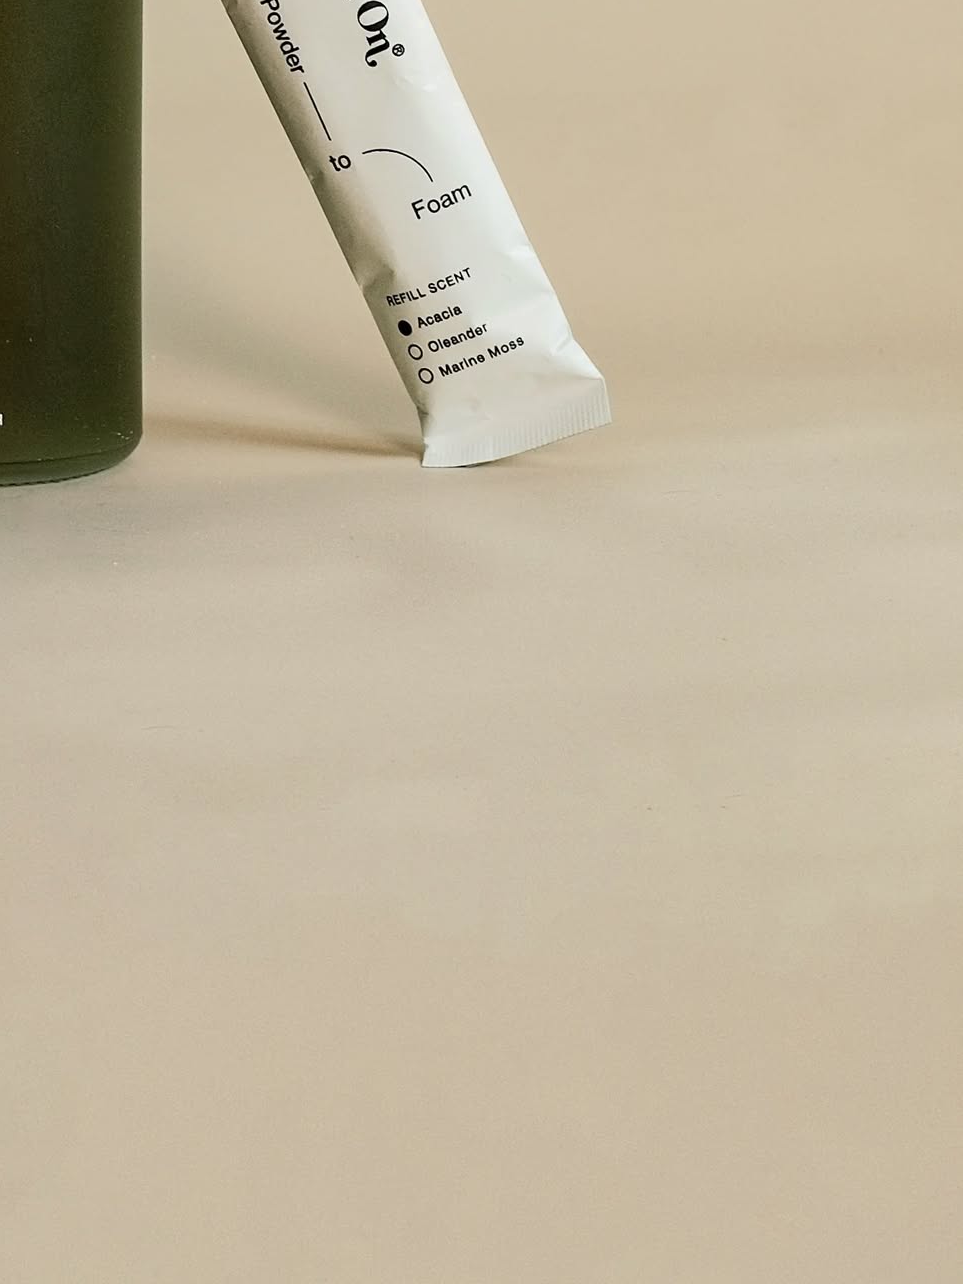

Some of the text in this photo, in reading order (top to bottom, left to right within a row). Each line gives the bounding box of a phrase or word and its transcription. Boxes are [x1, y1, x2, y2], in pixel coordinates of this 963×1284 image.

[328, 154, 352, 172] to
[411, 183, 472, 220] Foam
[387, 267, 471, 306] REFILL SCENT
[416, 304, 462, 329] Acacia
[428, 322, 487, 353] Oleander
[438, 335, 525, 377] Marine Moss
